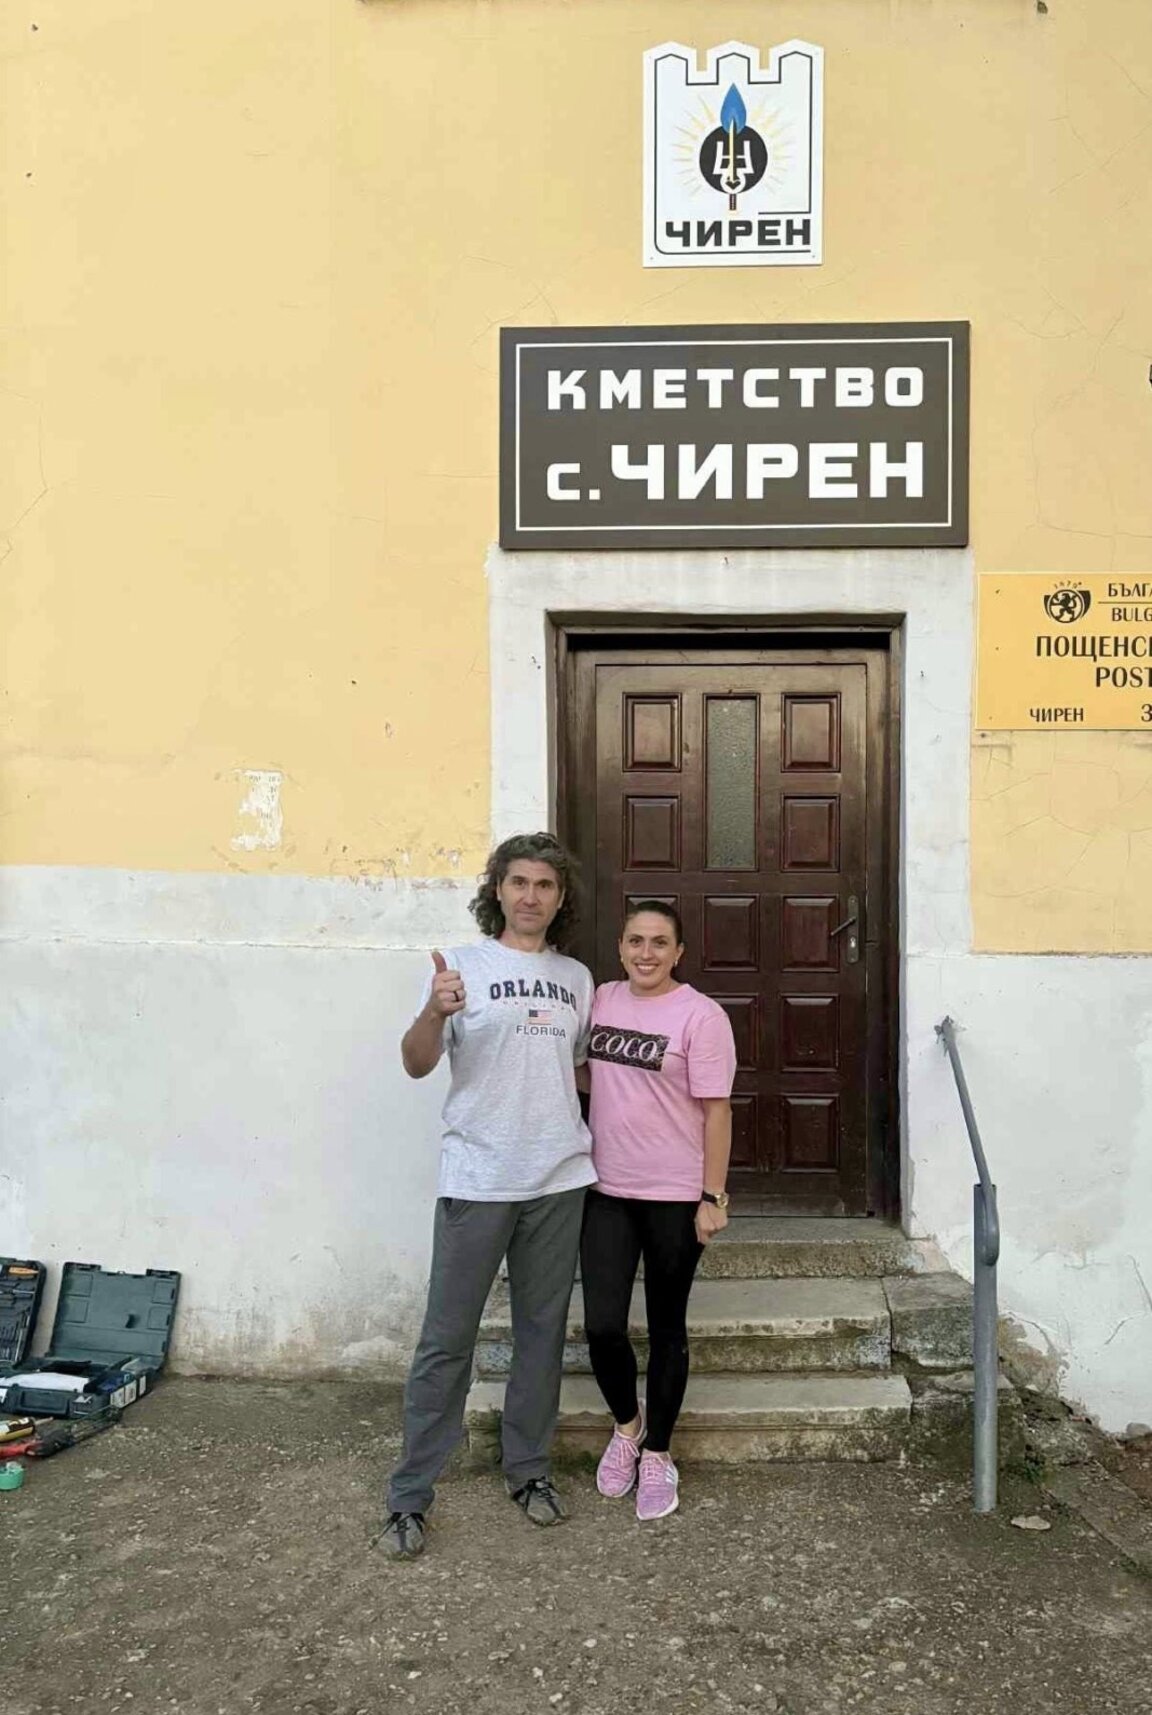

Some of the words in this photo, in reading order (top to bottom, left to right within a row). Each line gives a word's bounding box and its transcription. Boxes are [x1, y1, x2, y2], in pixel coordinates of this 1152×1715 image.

[666, 219, 811, 248] ЧИРЕН
[547, 367, 924, 410] КМЕТСТВО
[611, 442, 923, 500] ЧИРЕН
[1108, 583, 1152, 598] БЪЛГ
[1036, 635, 1152, 663] ПОЩЕНС
[1030, 708, 1084, 723] ЧИРЕН
[490, 979, 577, 1011] ORLANDO
[516, 1025, 567, 1038] FLORIDA
[591, 1032, 658, 1062] COCO
